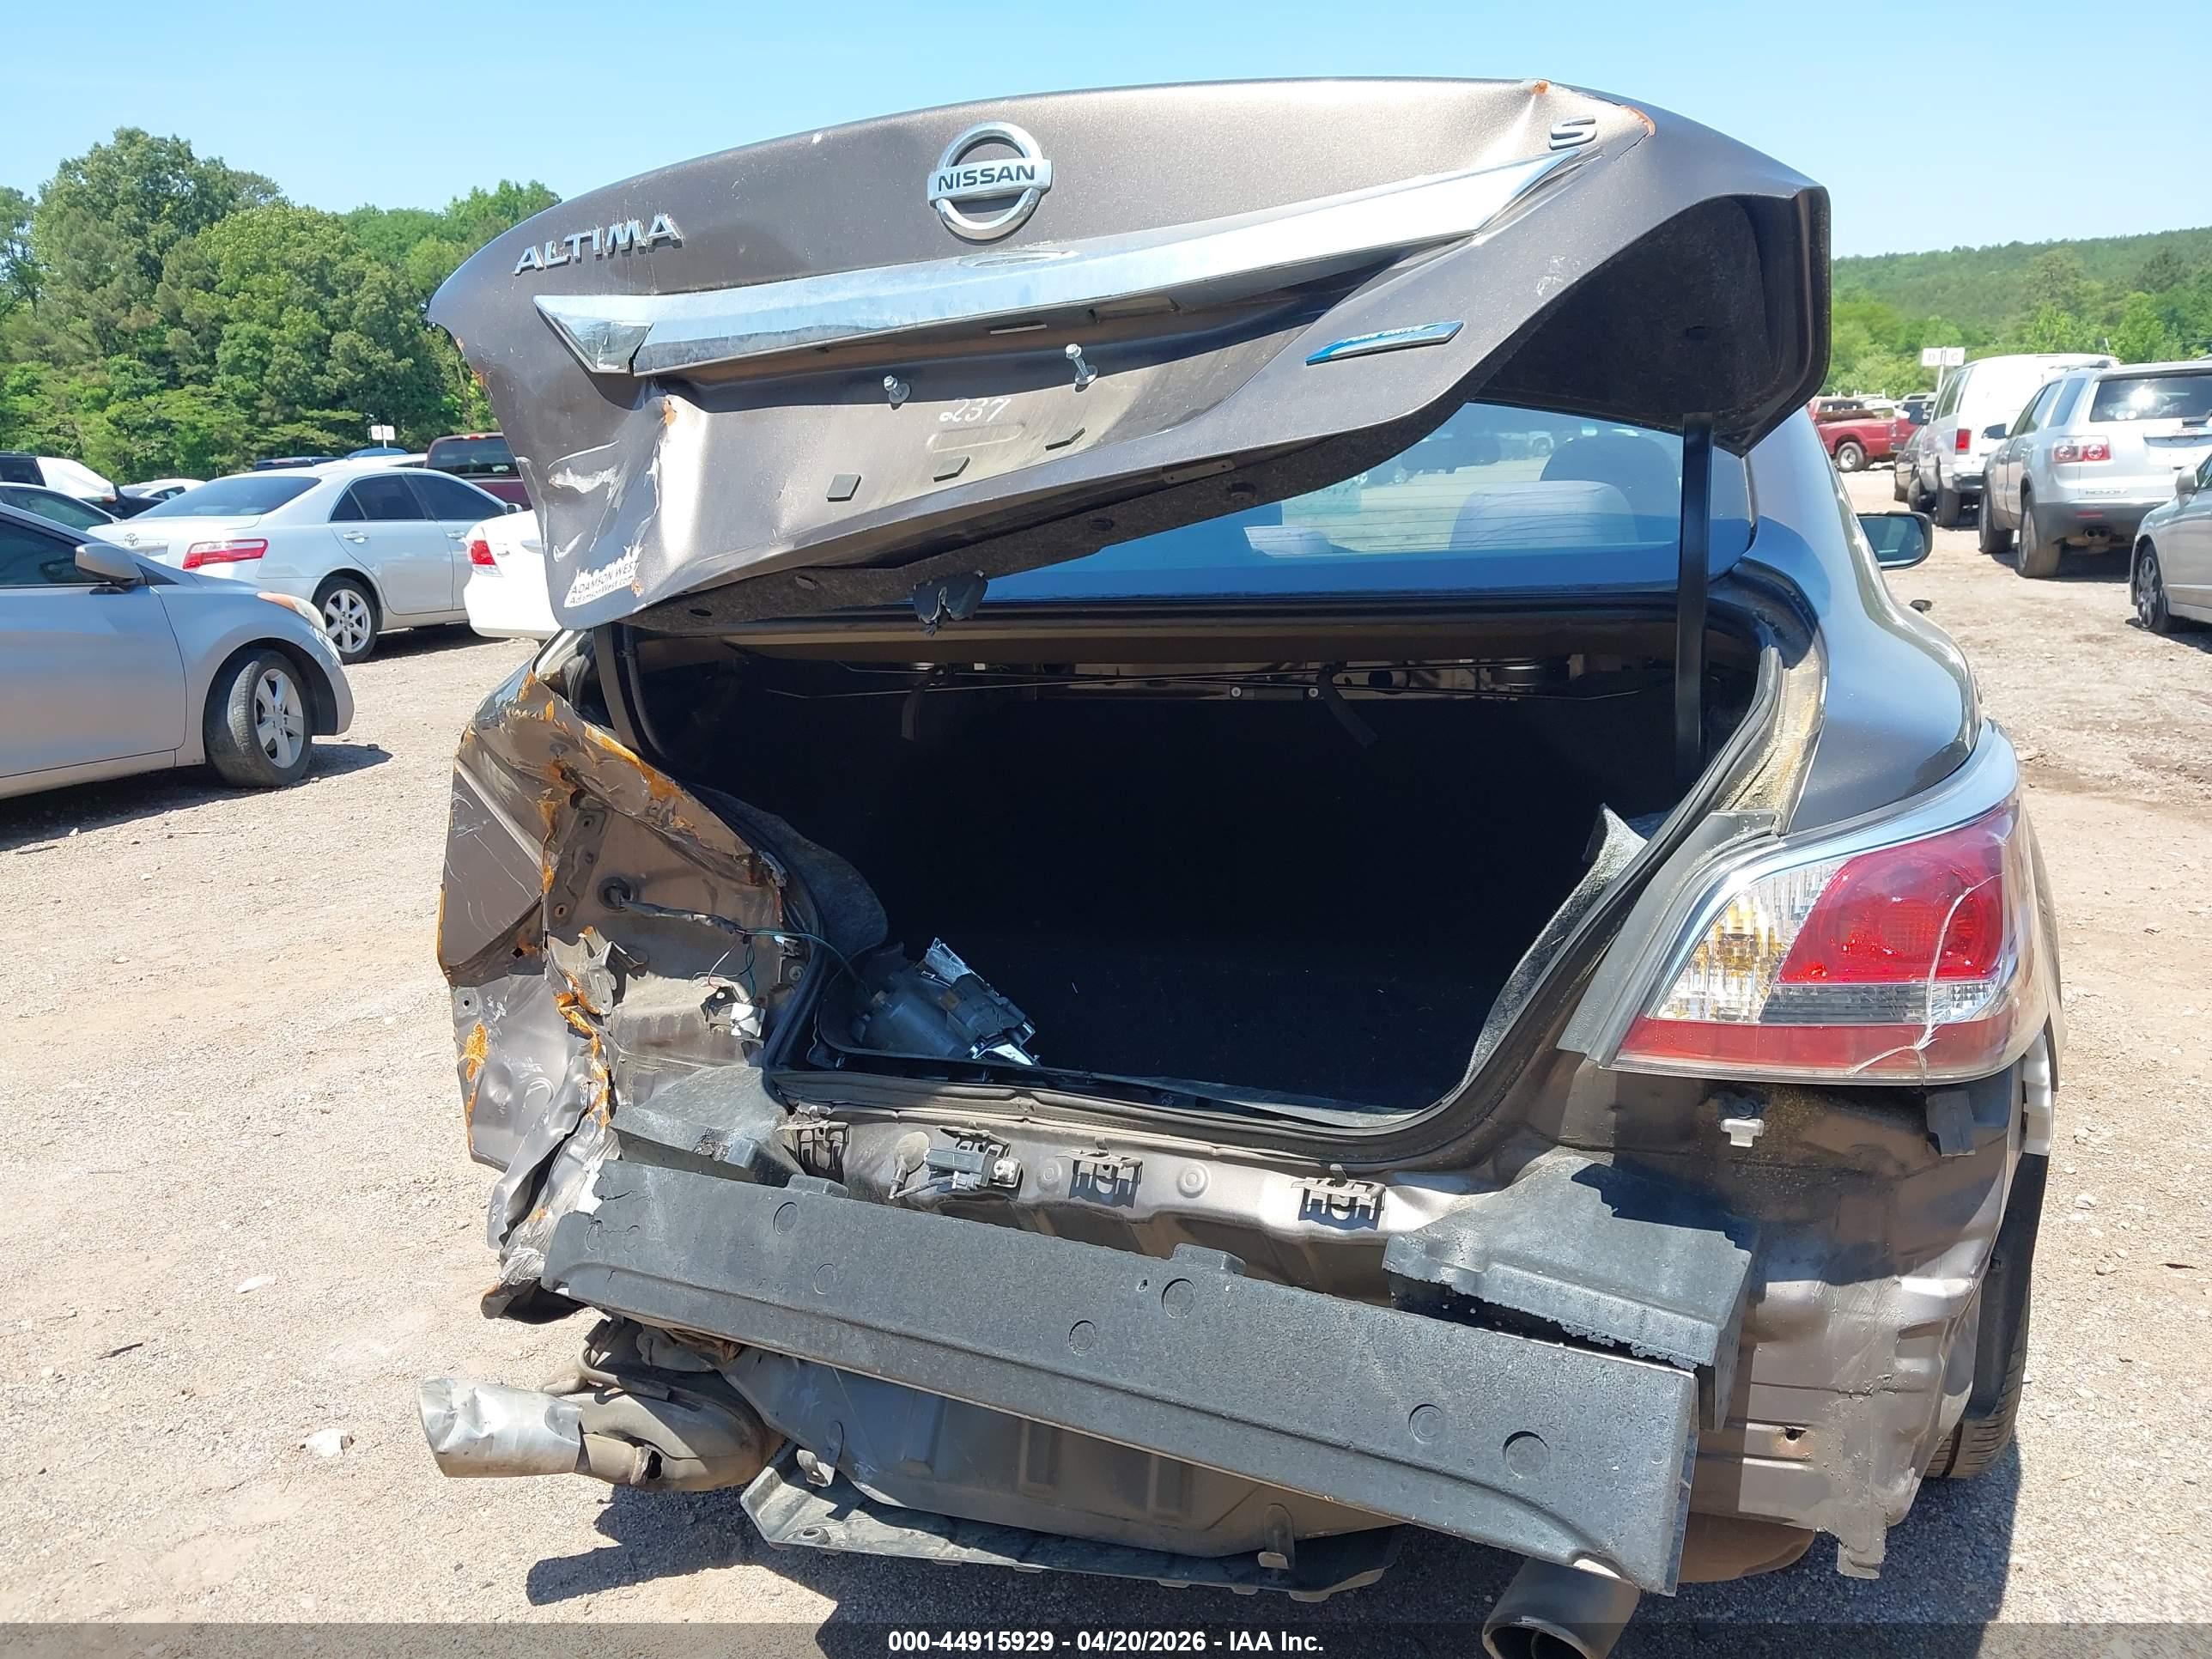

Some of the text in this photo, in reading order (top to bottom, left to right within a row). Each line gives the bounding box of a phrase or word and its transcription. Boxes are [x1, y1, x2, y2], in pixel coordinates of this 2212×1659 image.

[1548, 116, 1596, 150] S
[938, 164, 1036, 191] NISSAN
[513, 214, 684, 276] ALTIMA
